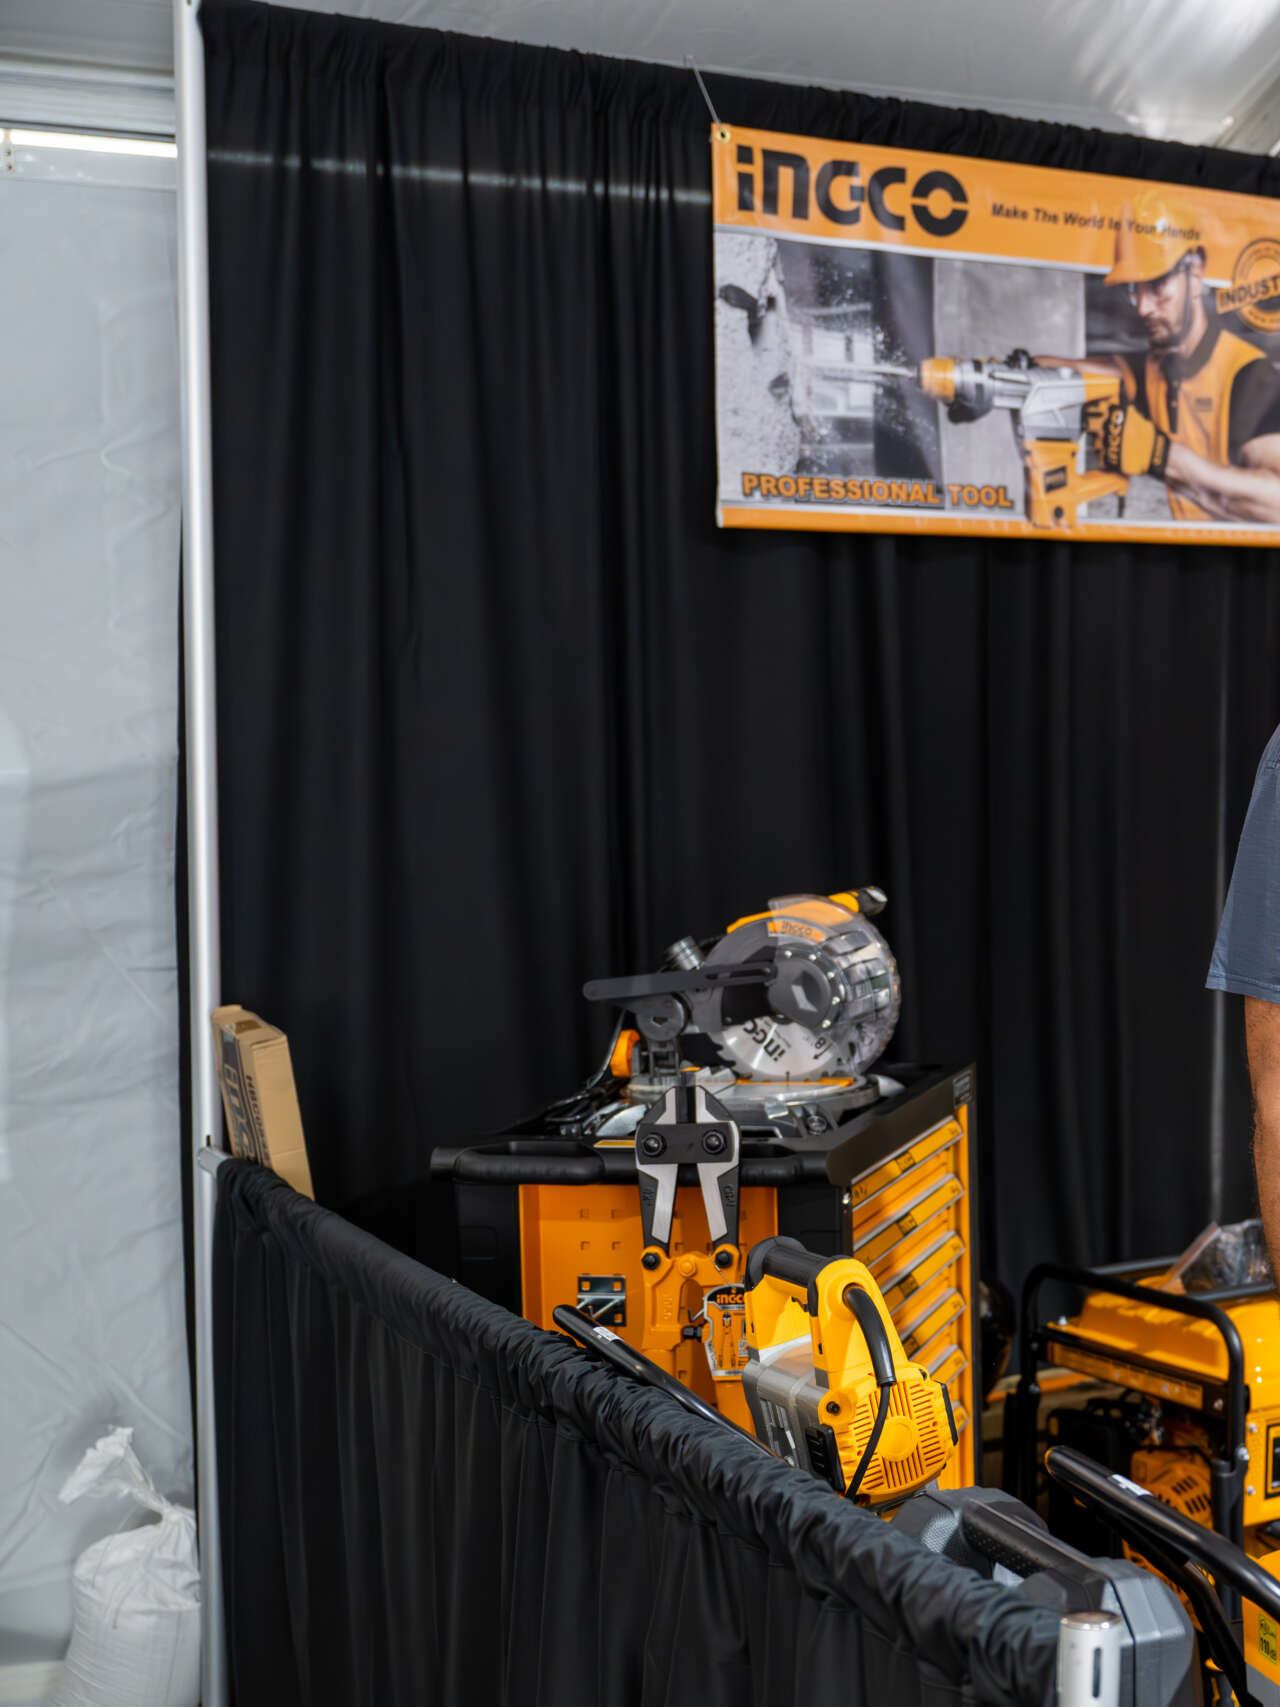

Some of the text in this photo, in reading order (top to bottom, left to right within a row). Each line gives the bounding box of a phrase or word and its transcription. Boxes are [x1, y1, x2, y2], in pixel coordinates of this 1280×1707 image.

[991, 203, 1029, 221] Make
[1033, 208, 1059, 225] The
[1063, 211, 1105, 230] World
[1128, 219, 1156, 236] Your
[742, 472, 1014, 509] PROFESSIONAL TOOL
